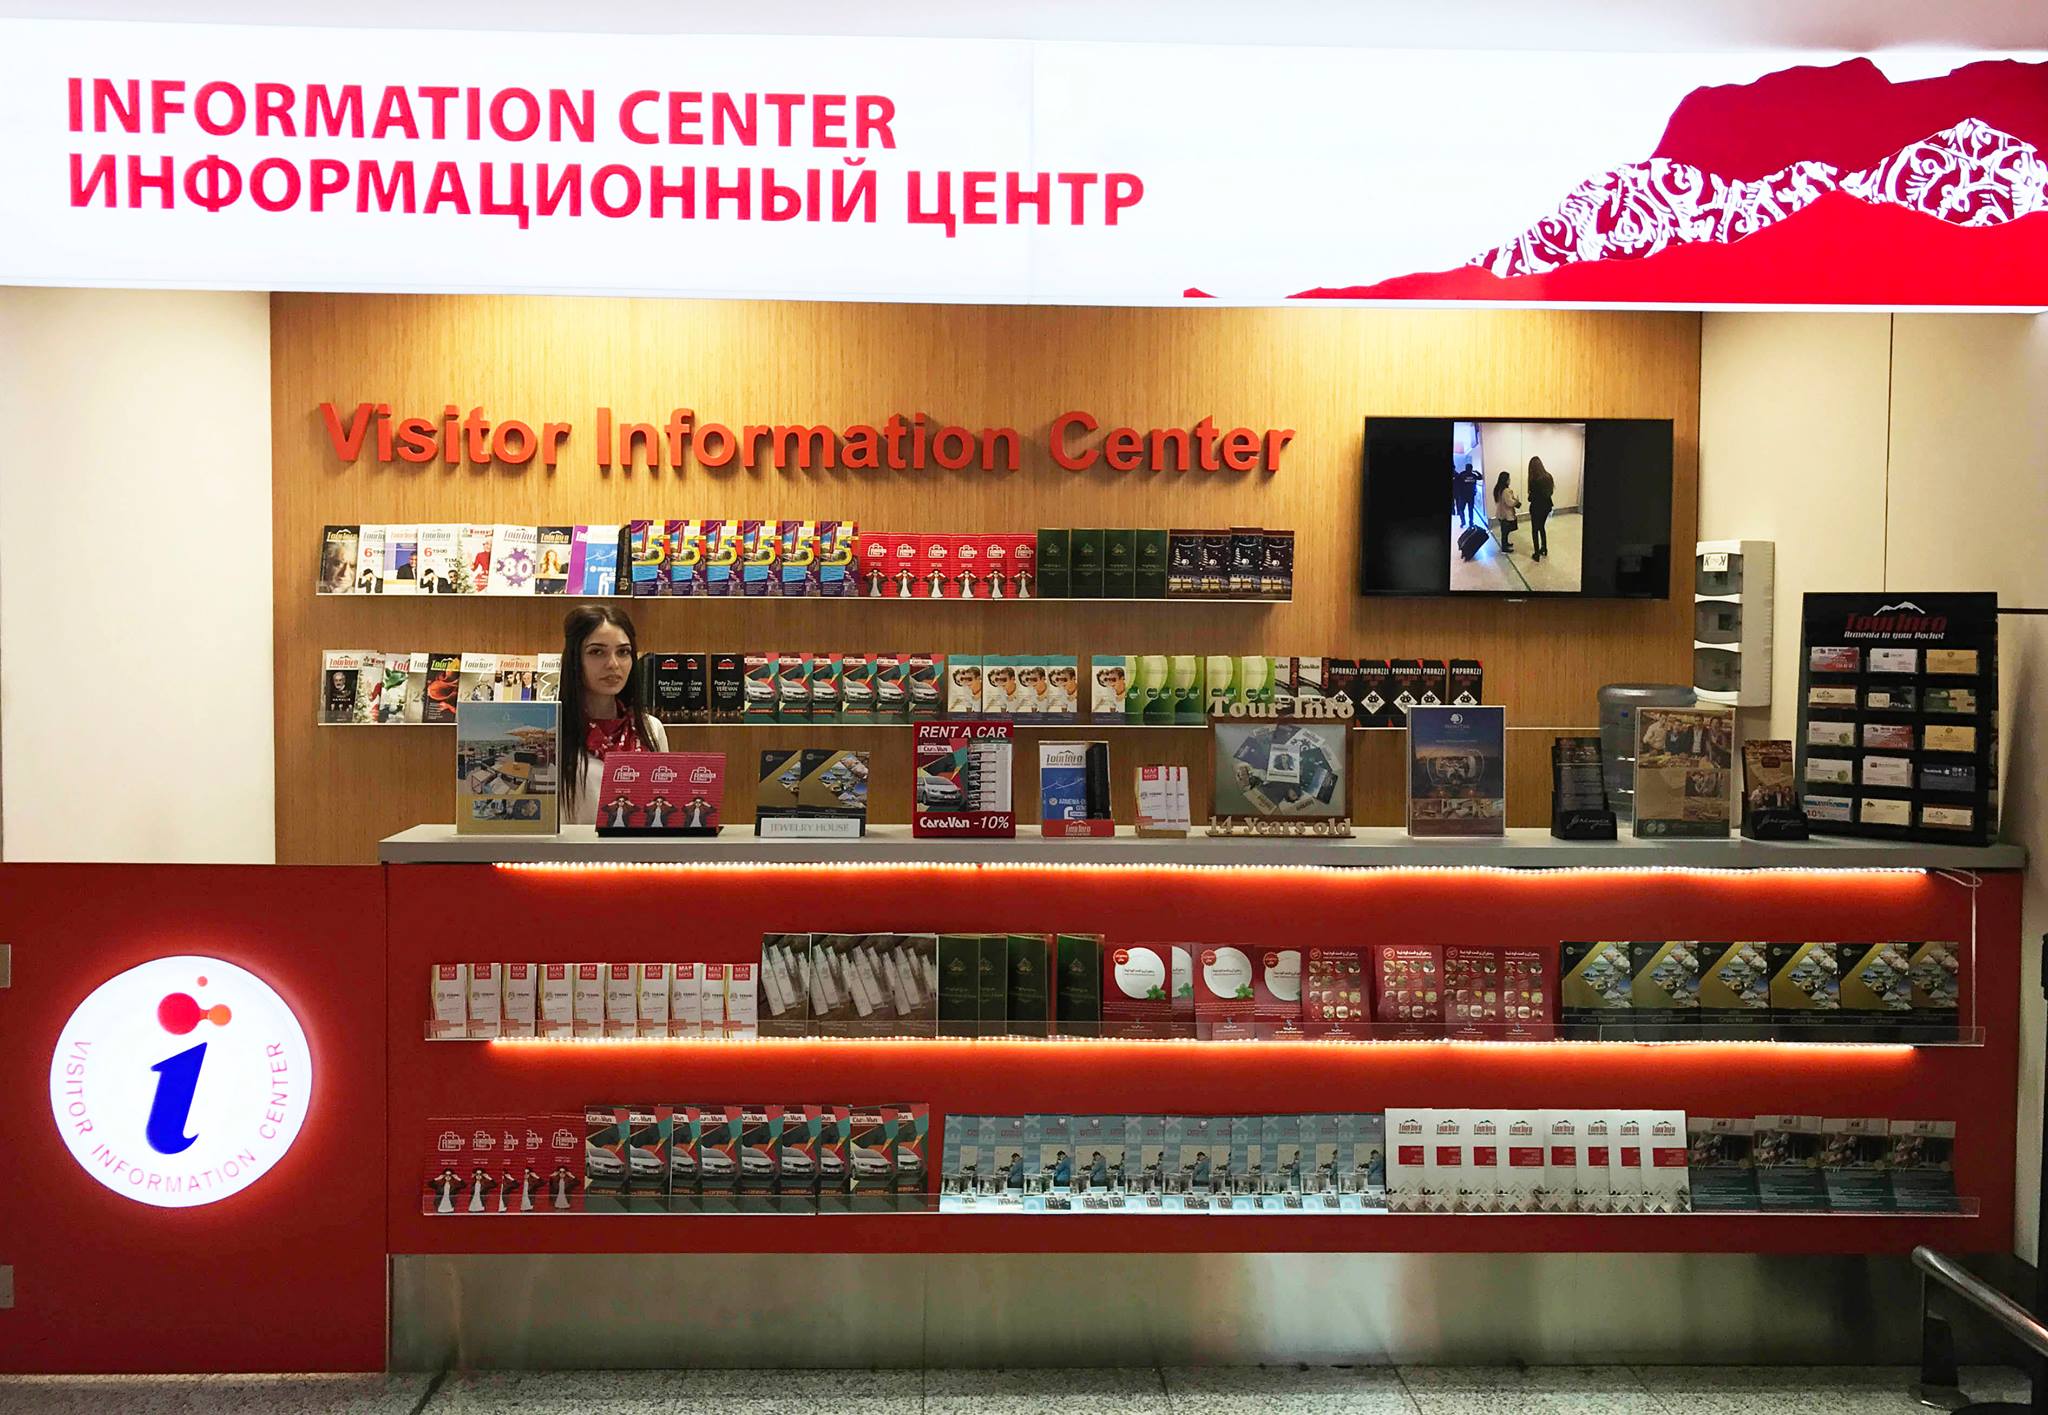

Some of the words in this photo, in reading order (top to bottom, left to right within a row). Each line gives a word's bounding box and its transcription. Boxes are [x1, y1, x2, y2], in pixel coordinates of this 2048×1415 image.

[68, 77, 595, 143] INFORMATION
[618, 90, 897, 149] CENTER
[69, 153, 877, 230] ИНФОРМАЦИОННЫЙ
[907, 171, 1145, 238] ЦЕНТР
[320, 402, 572, 466] Visitor
[596, 406, 1020, 471] Information
[1048, 410, 1296, 471] Center
[1844, 631, 1880, 639] Armenia
[1882, 631, 1891, 639] in
[1914, 631, 1945, 640] Pocket
[1211, 696, 1279, 718] Tour
[1293, 695, 1355, 718] Info
[919, 725, 959, 738] RENT
[961, 726, 972, 738] A
[976, 726, 1007, 738] CAR
[770, 823, 814, 832] JEWELRY
[816, 823, 849, 832] HOUSE
[919, 816, 970, 828] Car&Van
[973, 815, 1010, 829] -10%
[1208, 815, 1233, 834] 14
[1313, 817, 1351, 835] old
[66, 1041, 93, 1136] VISITOR
[91, 1143, 256, 1193] INFORMATION
[259, 1042, 289, 1140] CENTER
